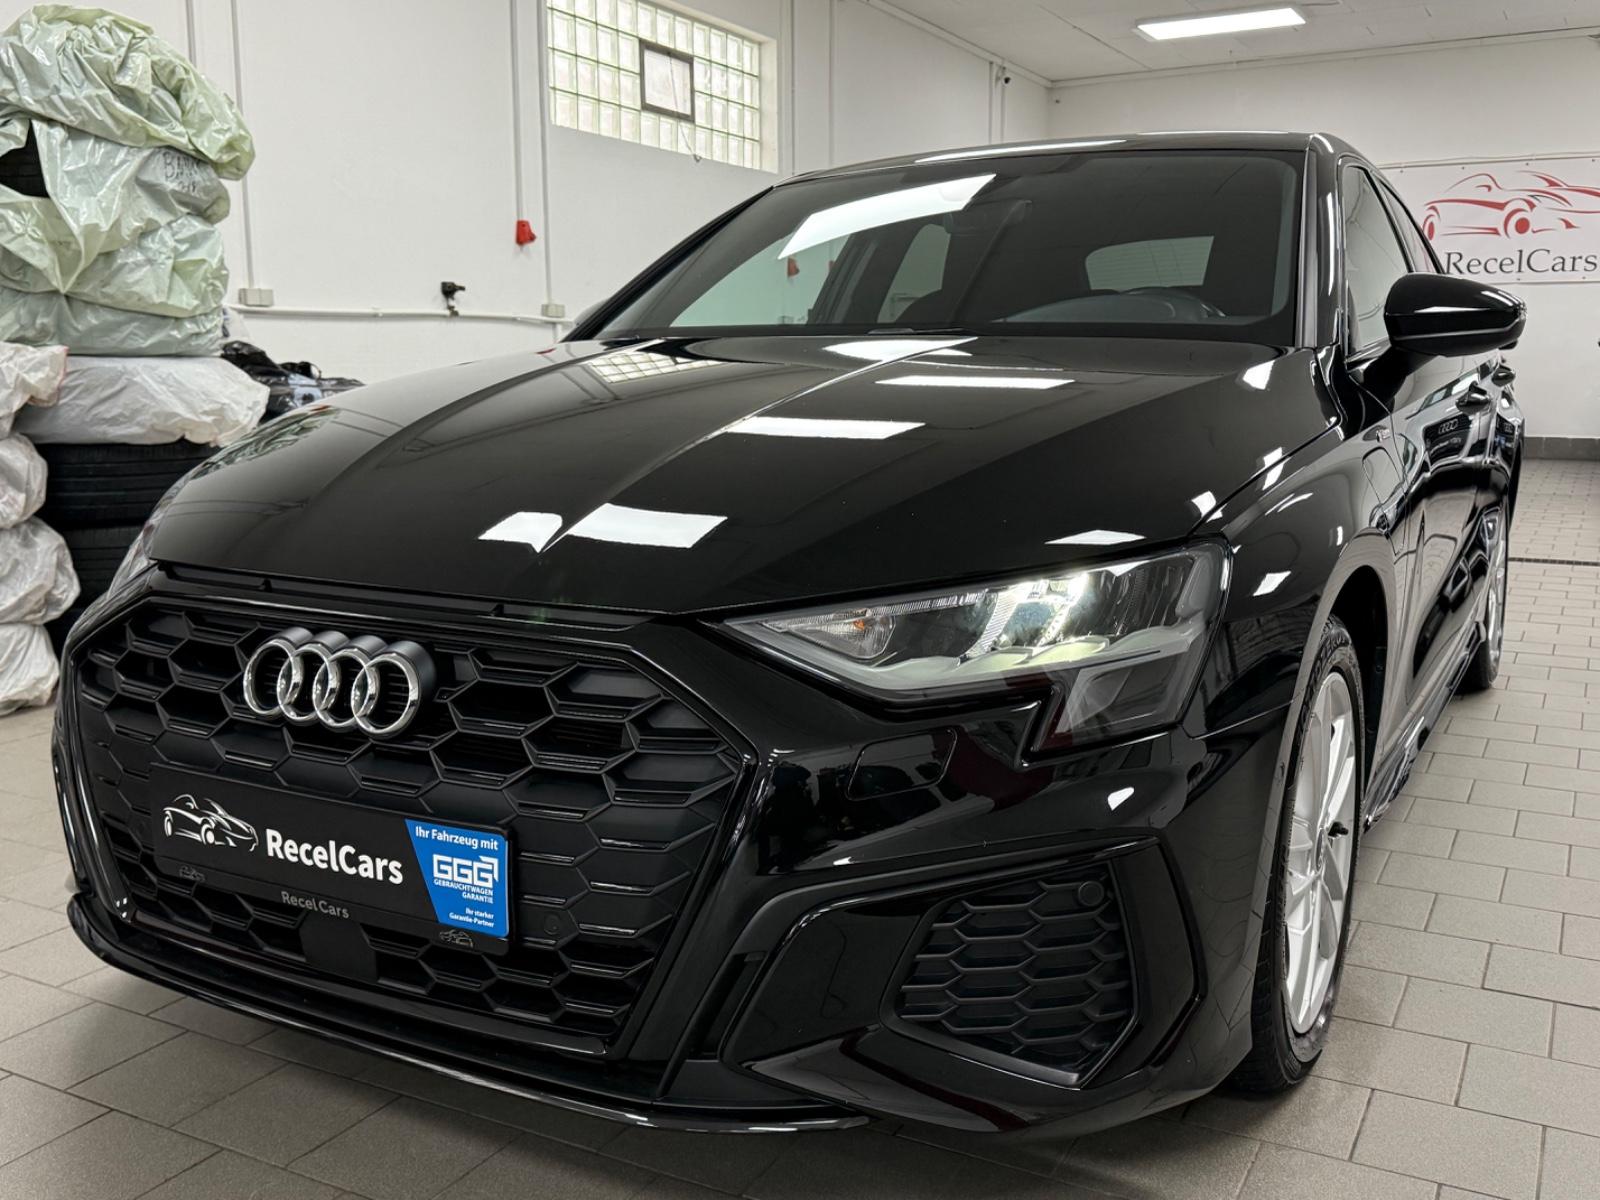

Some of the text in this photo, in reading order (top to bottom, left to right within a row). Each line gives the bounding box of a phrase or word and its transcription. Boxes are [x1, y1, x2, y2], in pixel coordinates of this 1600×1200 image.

[1444, 248, 1598, 275] RecelCars
[415, 826, 499, 851] Ihr Fahrzeug mit
[265, 828, 404, 885] RecelCars
[433, 878, 494, 896] GEBRAUCHTWAGEN
[462, 891, 494, 904] GARANTIE
